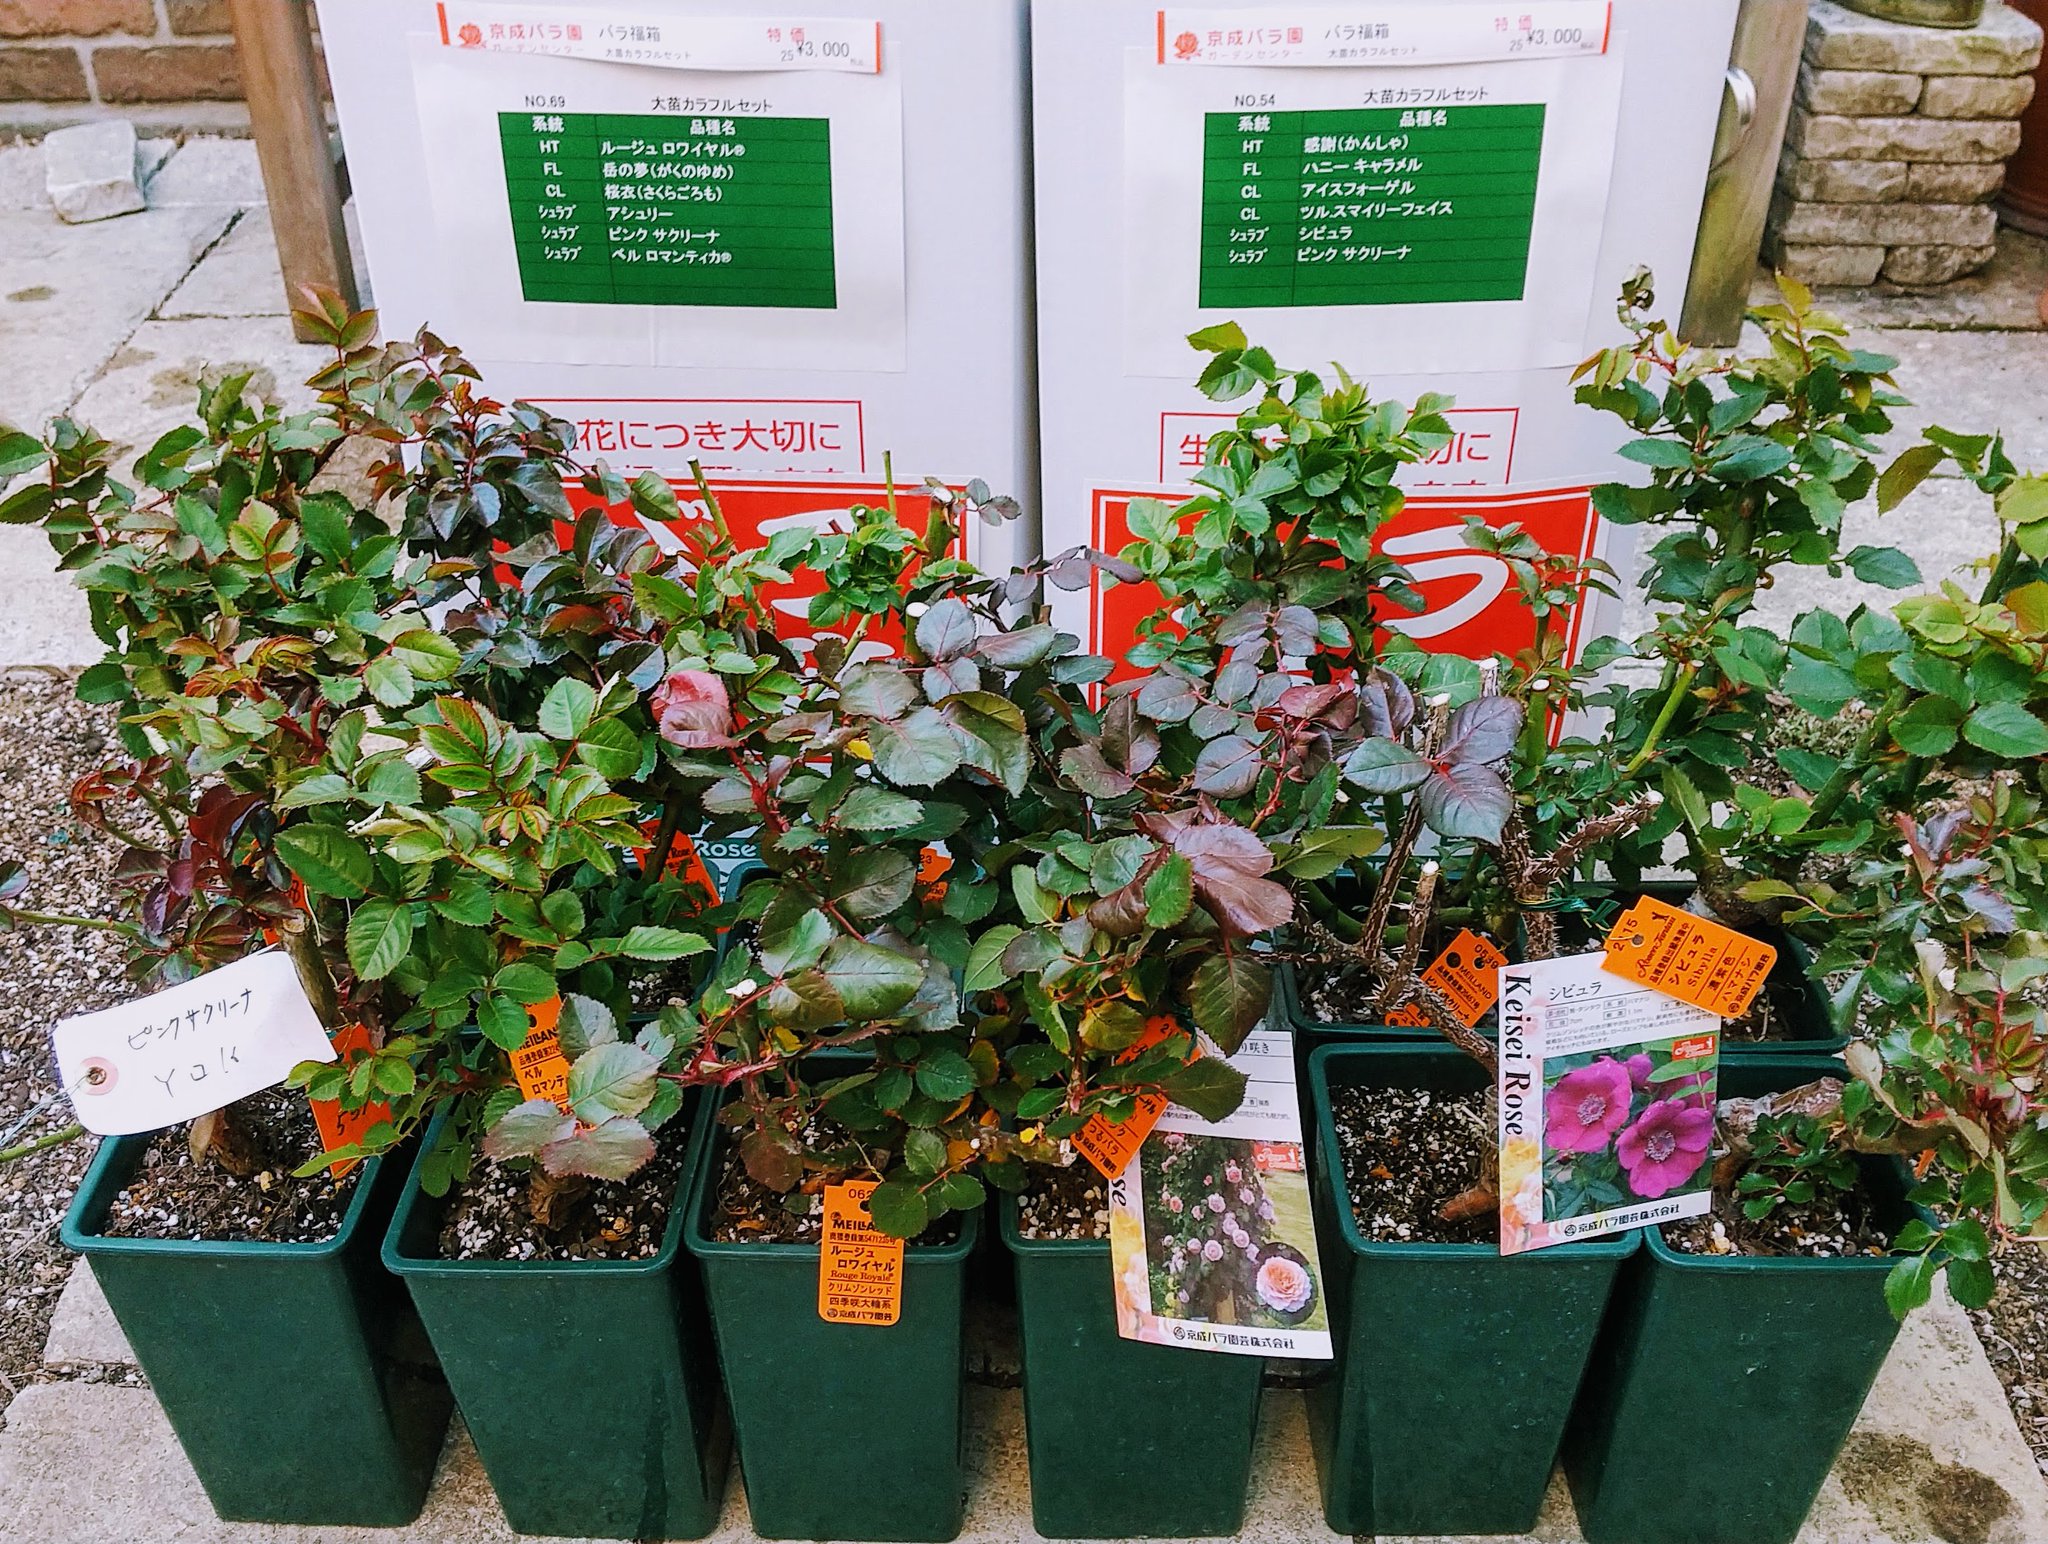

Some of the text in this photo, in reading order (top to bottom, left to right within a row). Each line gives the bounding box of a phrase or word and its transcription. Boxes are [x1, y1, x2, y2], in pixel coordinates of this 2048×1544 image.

[490, 24, 582, 41] 京成バラ園
[599, 24, 661, 42] バラ福箱
[1206, 27, 1303, 48] 京成バラ園
[1324, 24, 1390, 41] バラ福箱
[525, 95, 566, 108] NO.69
[1234, 94, 1276, 107] NO.54
[1363, 86, 1489, 105] 大苗カラフルセット
[651, 96, 773, 114] 大苗カラフルセット
[532, 116, 565, 133] 系統
[690, 118, 736, 136] 品種名
[1238, 114, 1271, 132] 系統
[1400, 110, 1448, 128] 品種名
[539, 140, 561, 154] HT
[601, 140, 658, 156] ルージュ
[1242, 139, 1264, 154] HT
[1304, 134, 1409, 154] 感謝(かんしゃ)
[544, 162, 563, 176] FL
[602, 162, 734, 180] 岳の夢(がくのゆめ)
[1242, 162, 1262, 176] FL
[1302, 157, 1423, 175] ハニー キャラメル
[545, 184, 566, 198] CL
[604, 184, 723, 202] 桜衣(さくらごろも)
[1240, 185, 1262, 199] CL
[1301, 180, 1416, 198] アイスフォーゲル
[606, 206, 674, 221] アシュリー
[1240, 207, 1261, 222] CL
[608, 226, 720, 244] ピンク サクリーナ
[1298, 226, 1353, 242] シビュラ
[1297, 246, 1412, 262] ピンク サクリーナ
[574, 419, 841, 452] 花につき大切に
[1612, 918, 1638, 952] 215
[1687, 947, 1718, 987] Sibylla
[1458, 964, 1492, 1000] MEILLAND
[1722, 957, 1750, 1001] ハマナシ
[1549, 981, 1602, 1001] シビュラ
[127, 988, 253, 1050] ピンクサクリーナ
[1504, 974, 1532, 1135] Keisei Rose
[524, 1067, 543, 1080] ベル
[832, 1219, 879, 1231] MEILLA
[830, 1246, 875, 1258] ルージュ
[831, 1270, 858, 1280] Rouge
[827, 1282, 893, 1296] クリムゾンレッド
[829, 1297, 892, 1310] 四季咲大輪系
